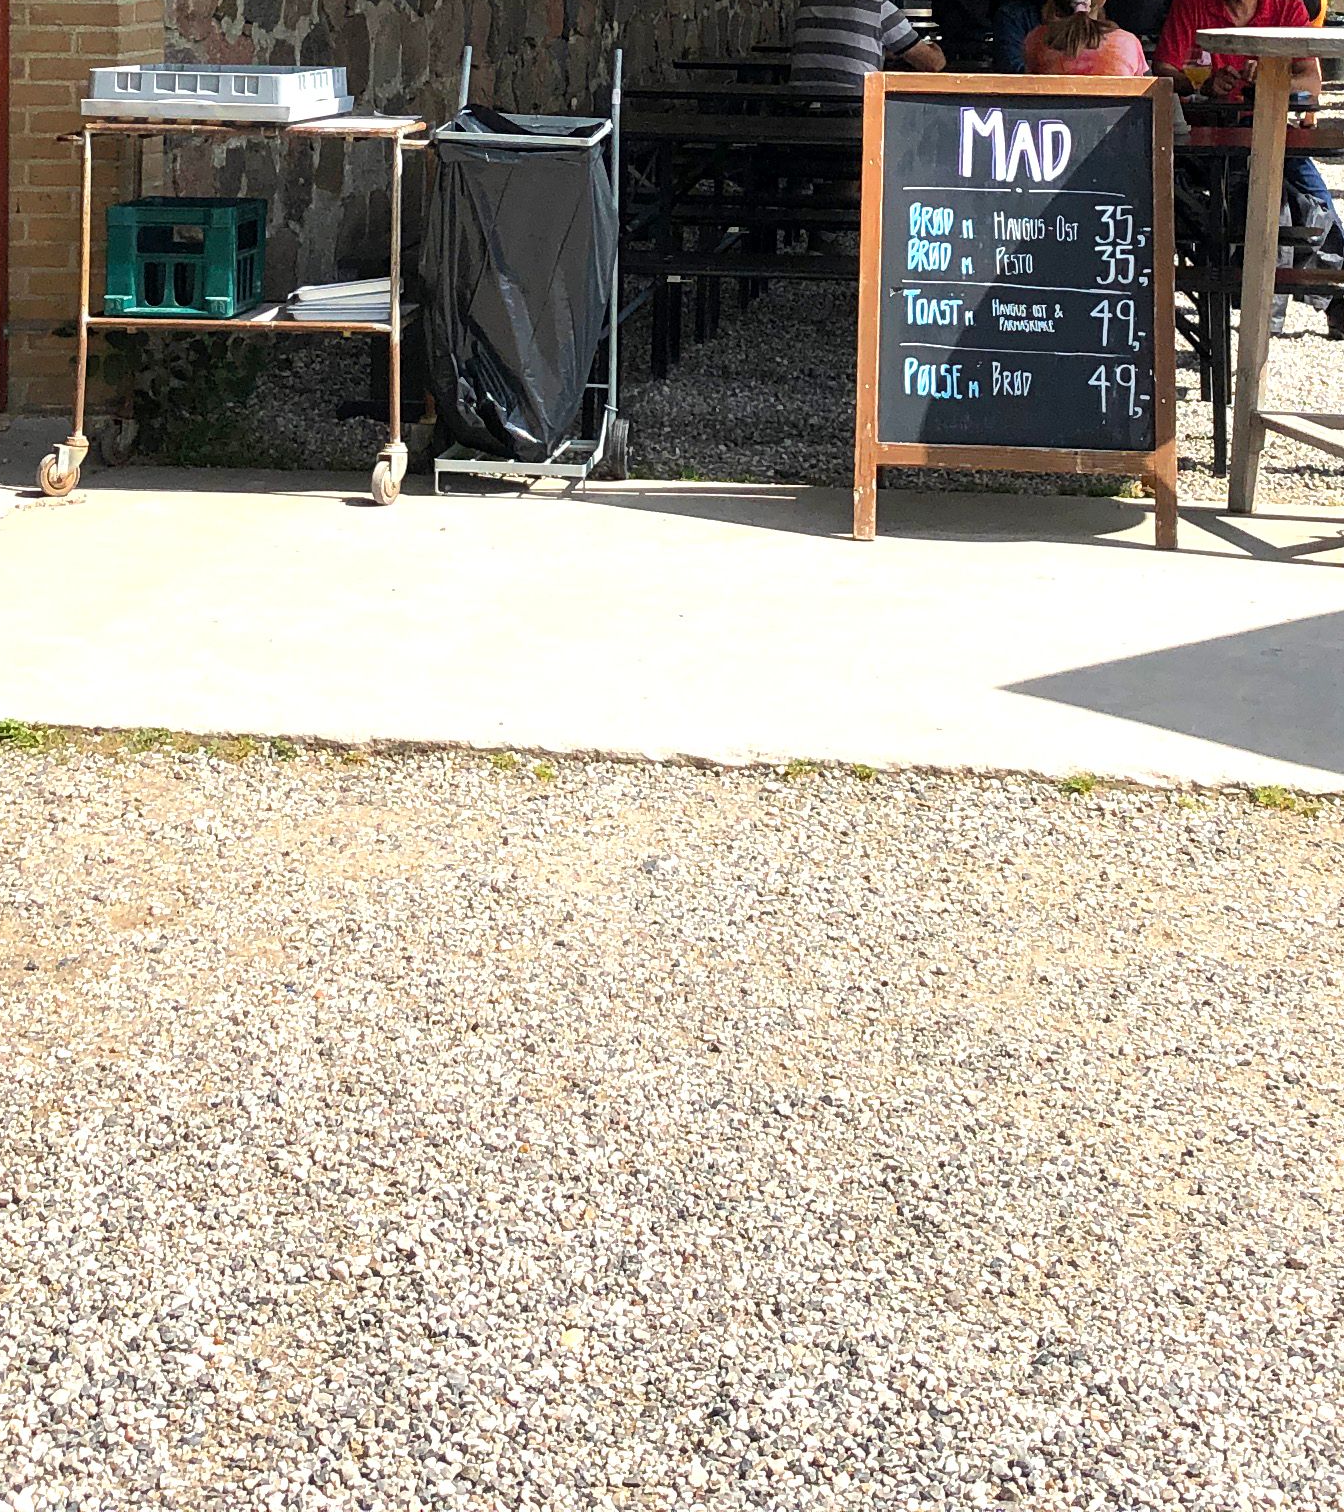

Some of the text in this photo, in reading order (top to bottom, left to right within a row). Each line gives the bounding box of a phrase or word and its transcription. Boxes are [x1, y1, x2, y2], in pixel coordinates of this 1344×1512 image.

[959, 107, 1073, 183] MAD
[908, 201, 954, 237] BRØD
[907, 238, 952, 273] BRØD
[996, 246, 1034, 276] PESTO
[902, 288, 964, 326] TOAST
[1054, 303, 1064, 319] &
[903, 356, 964, 400] PØLSE
[991, 361, 1033, 397] BRØD
